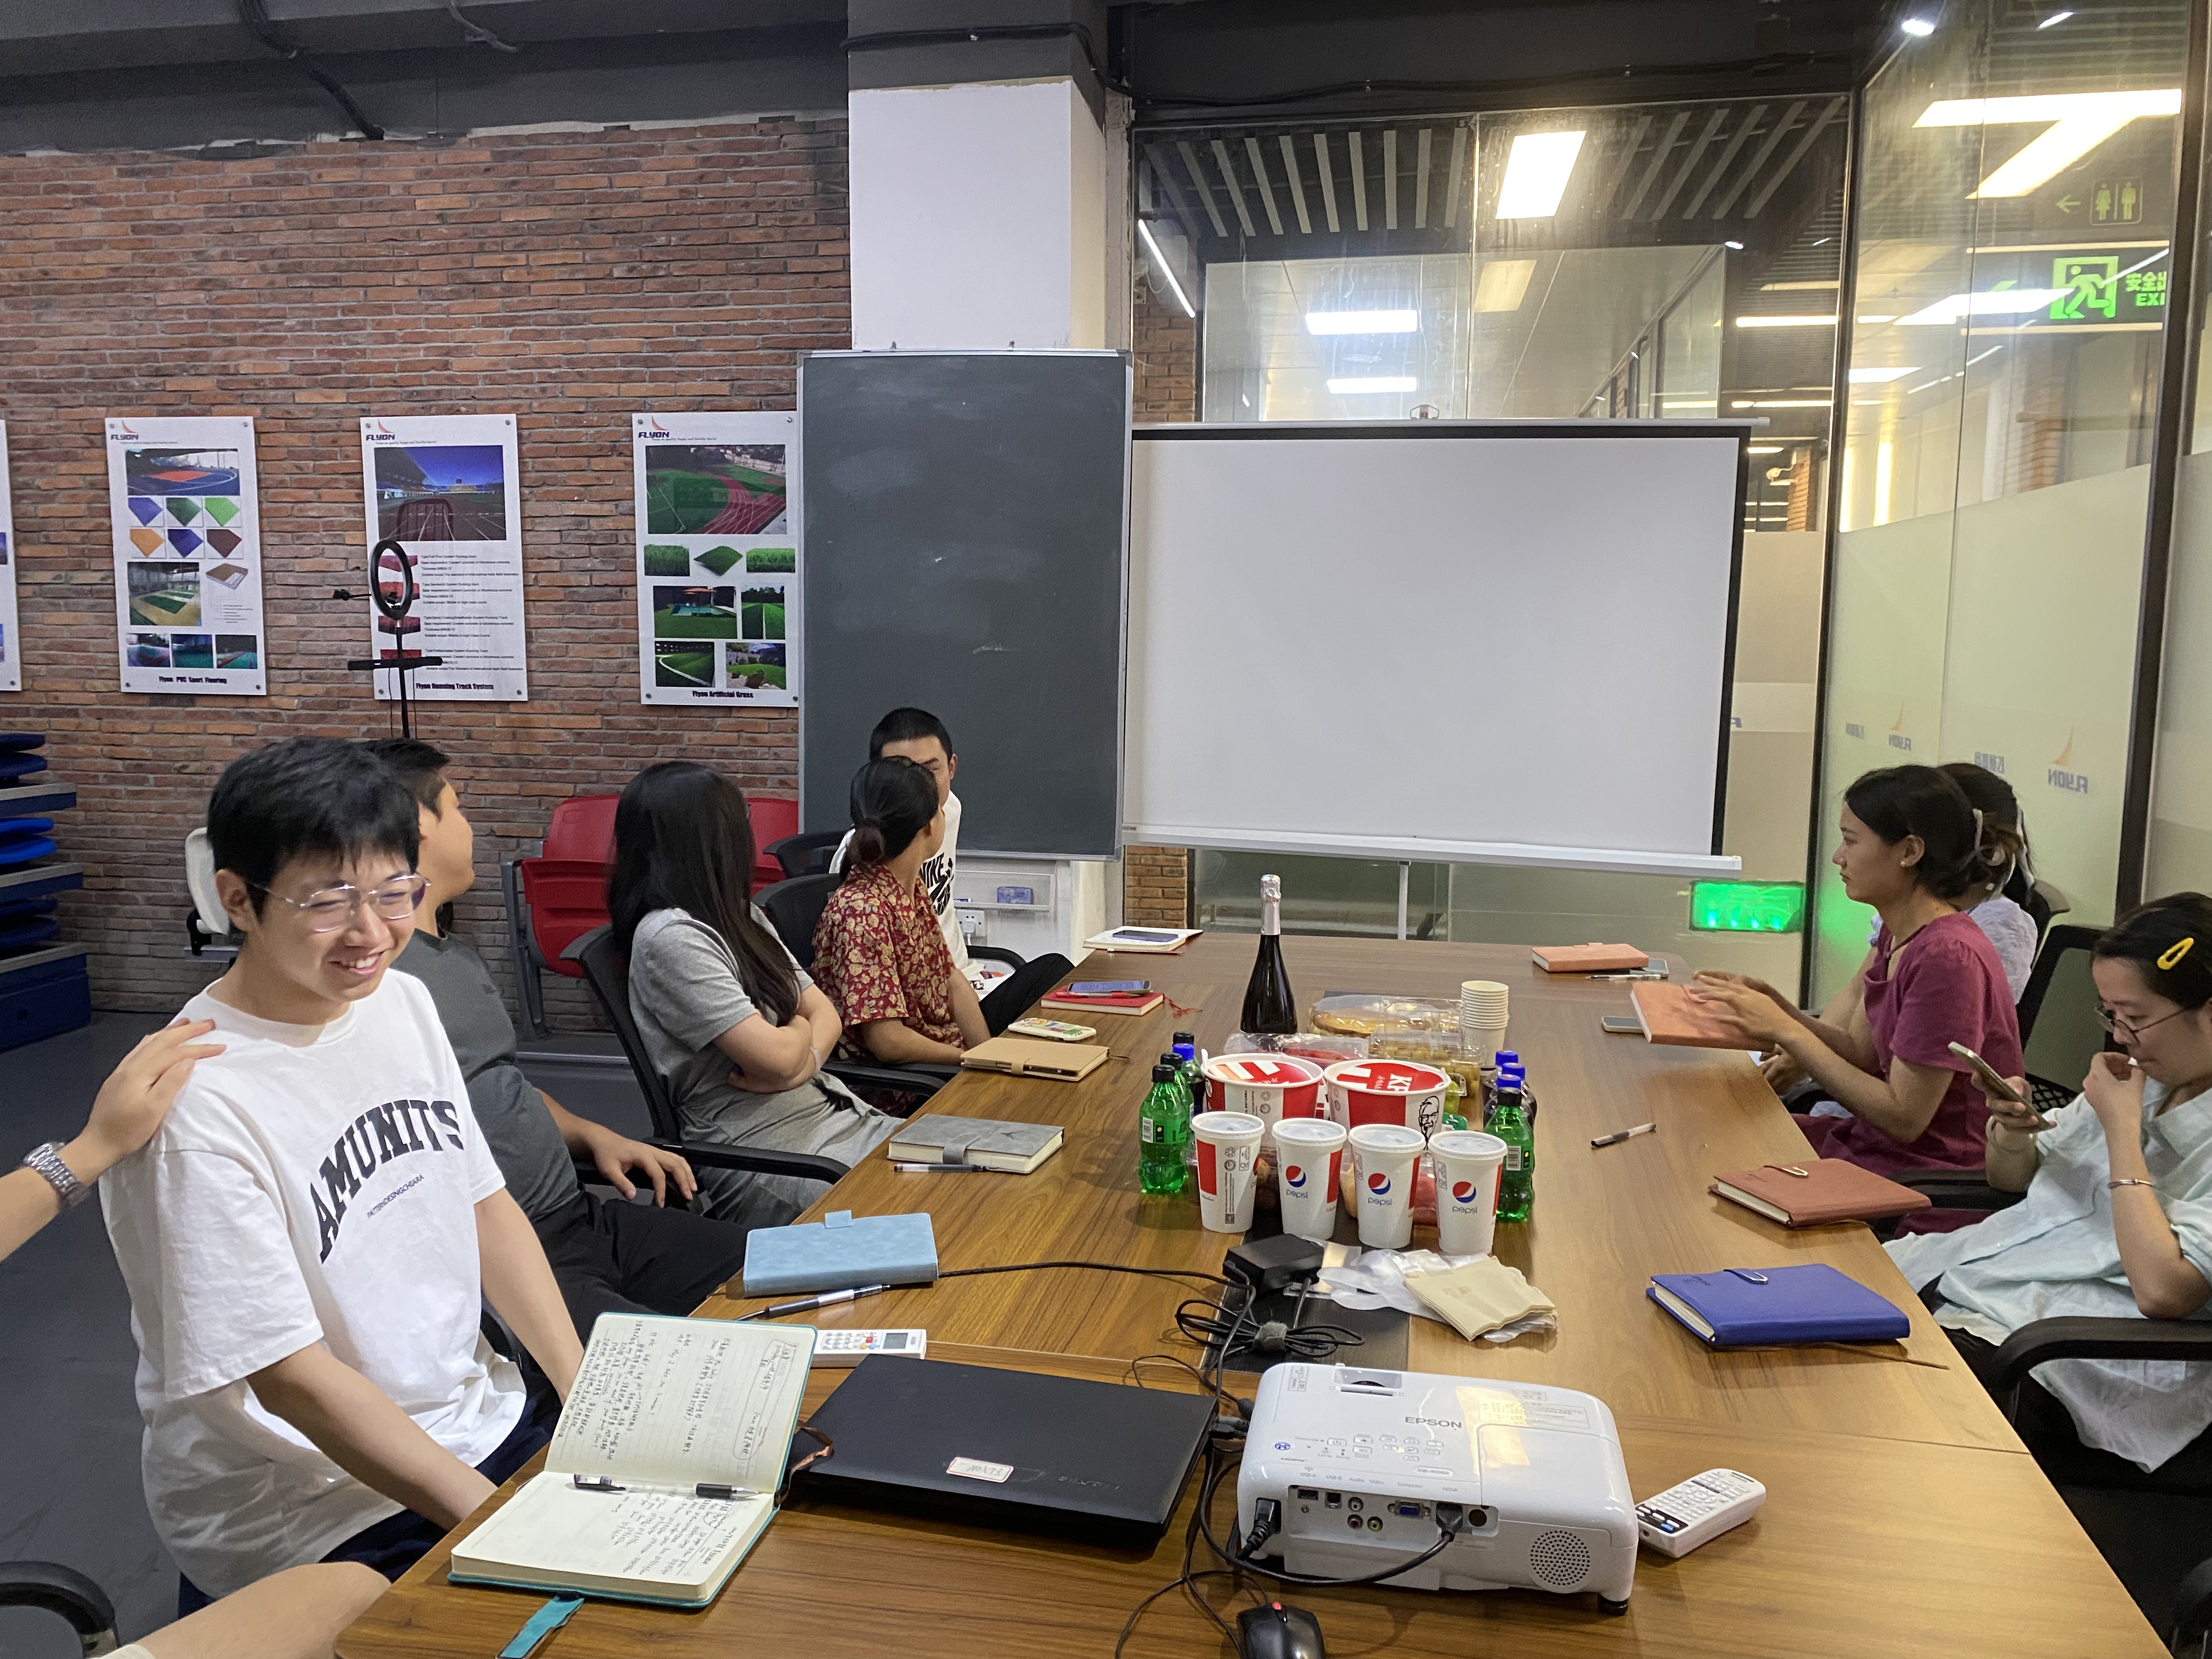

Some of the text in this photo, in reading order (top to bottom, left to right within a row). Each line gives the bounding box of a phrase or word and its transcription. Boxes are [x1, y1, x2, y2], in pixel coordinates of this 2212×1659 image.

[2136, 292, 2165, 306] EXI
[1387, 1074, 1413, 1091] KF
[310, 1099, 464, 1265] AMUNITS
[1286, 1189, 1308, 1199] pepsi
[1368, 1198, 1392, 1206] pepsi
[1452, 1206, 1477, 1215] pepsi
[1405, 1417, 1462, 1429] EPSON
